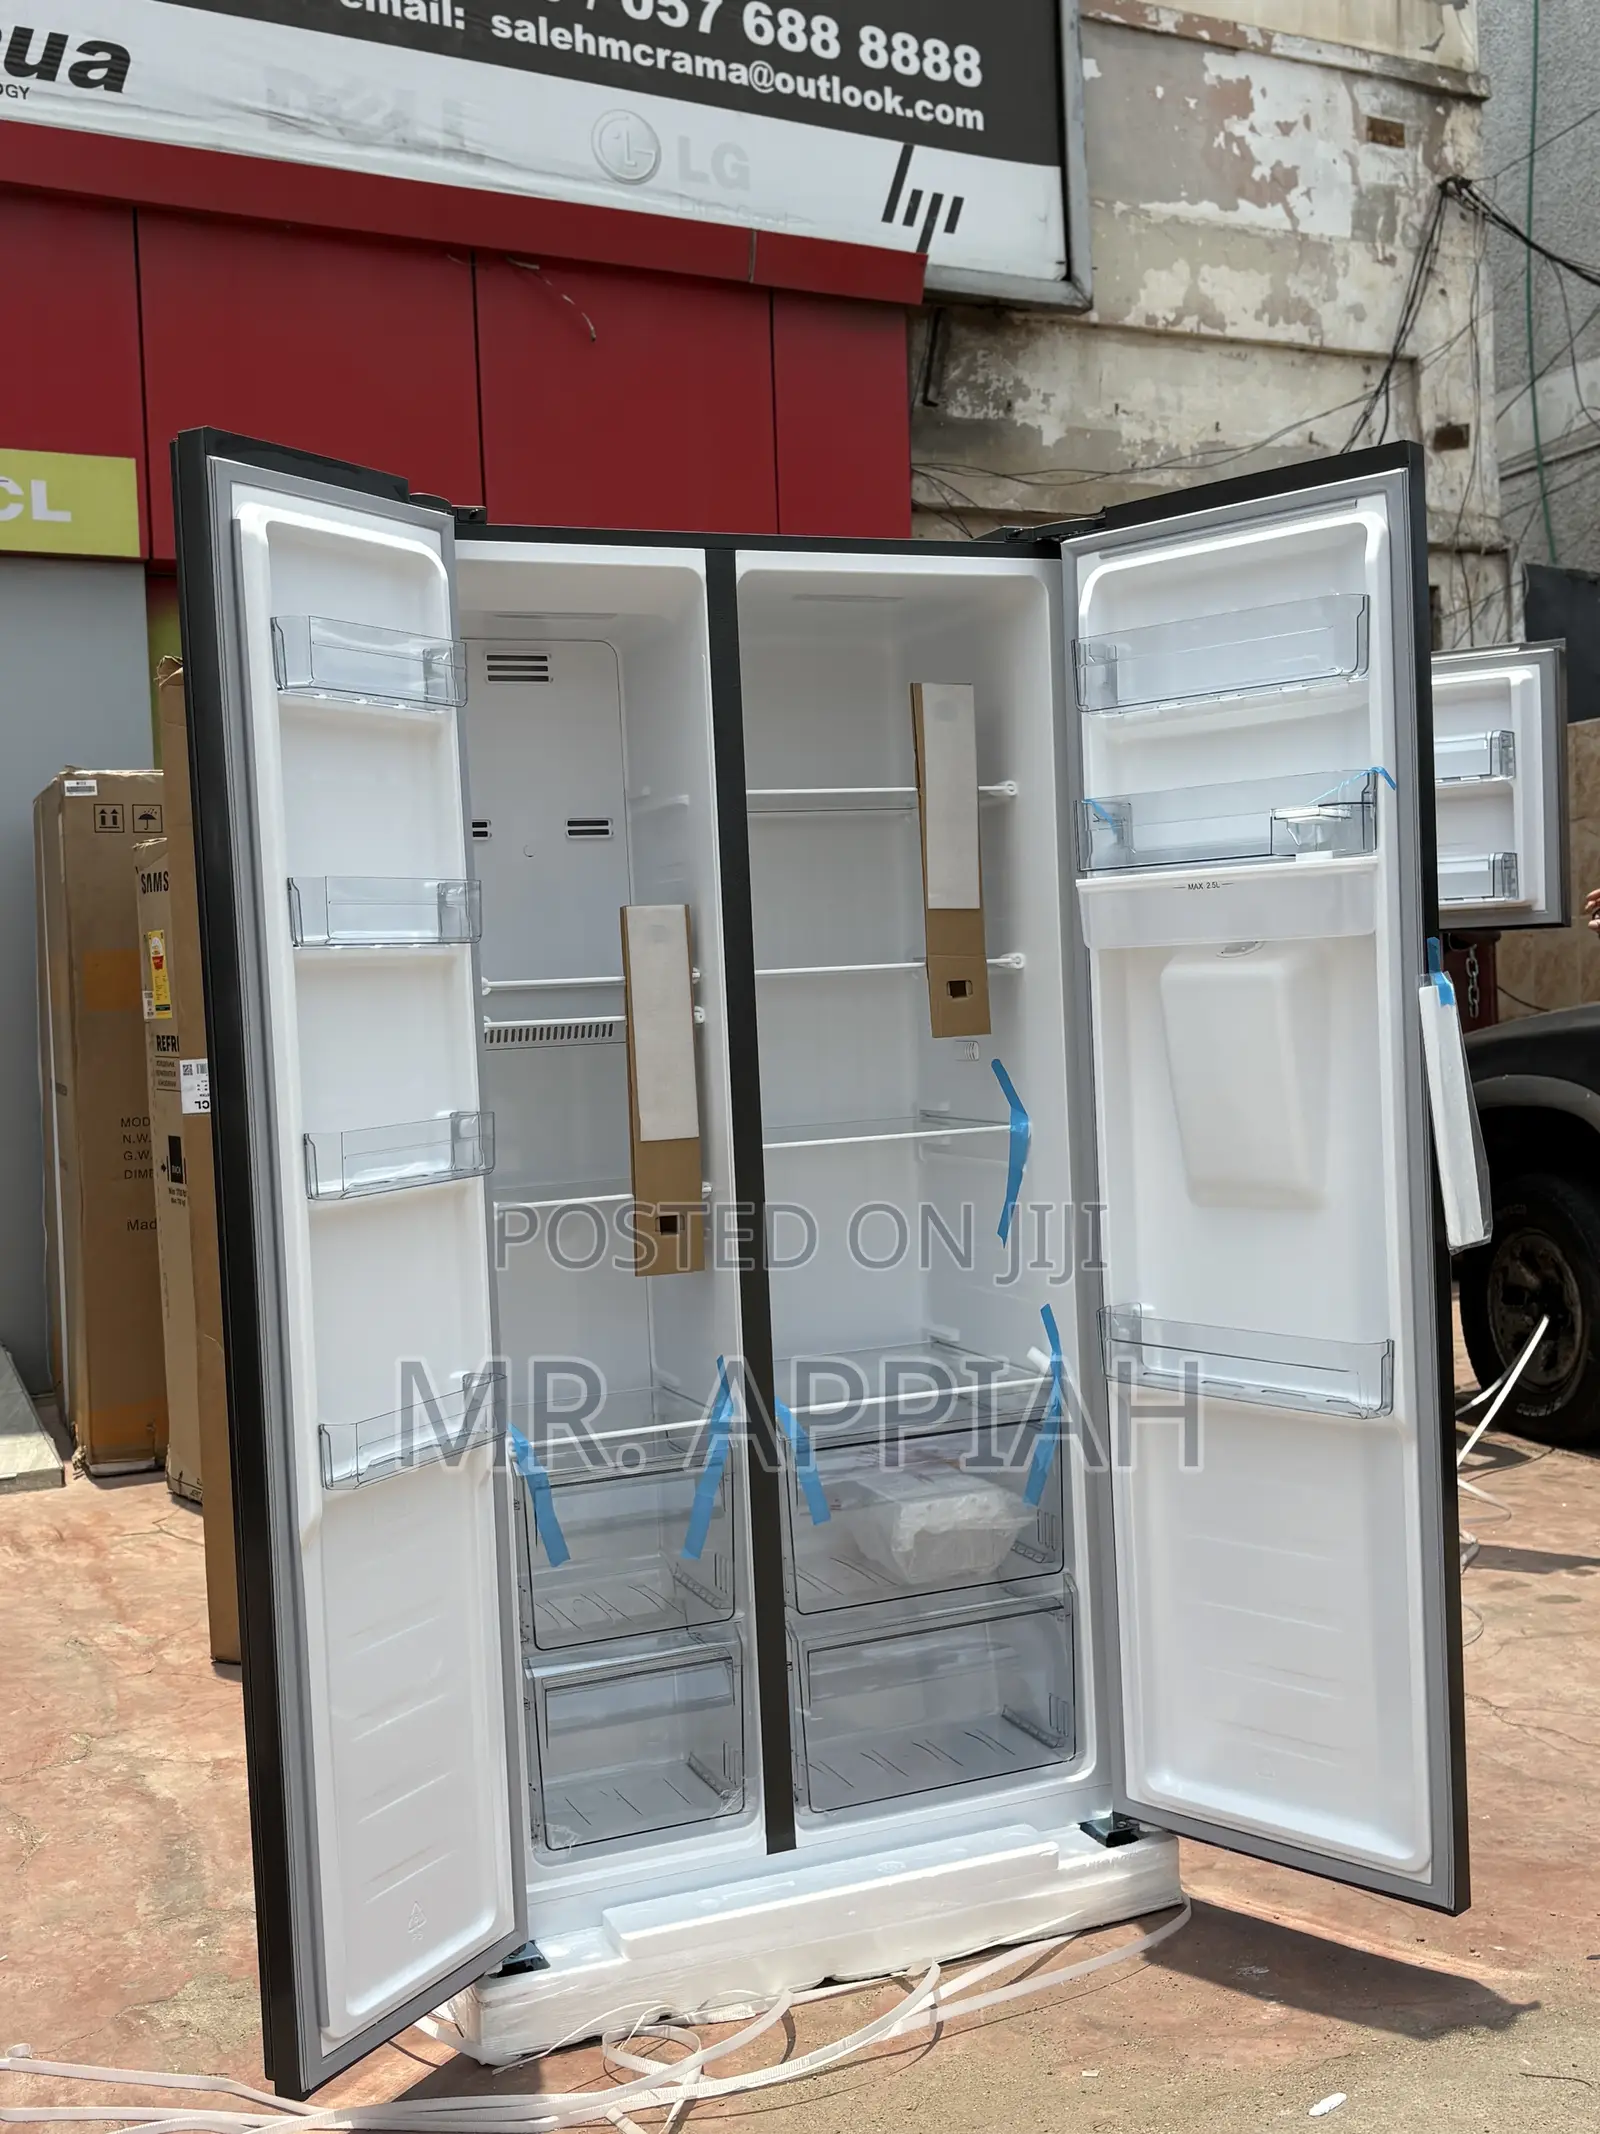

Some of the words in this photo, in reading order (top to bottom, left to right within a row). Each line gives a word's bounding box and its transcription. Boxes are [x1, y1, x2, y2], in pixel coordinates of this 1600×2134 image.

[0, 25, 131, 93] ua
[491, 13, 986, 132] salehmcrama@outlook.com
[742, 0, 842, 59] 688
[858, 25, 983, 88] 8888
[0, 83, 30, 100] GY
[678, 135, 751, 191] LG
[1187, 882, 1204, 891] MAX
